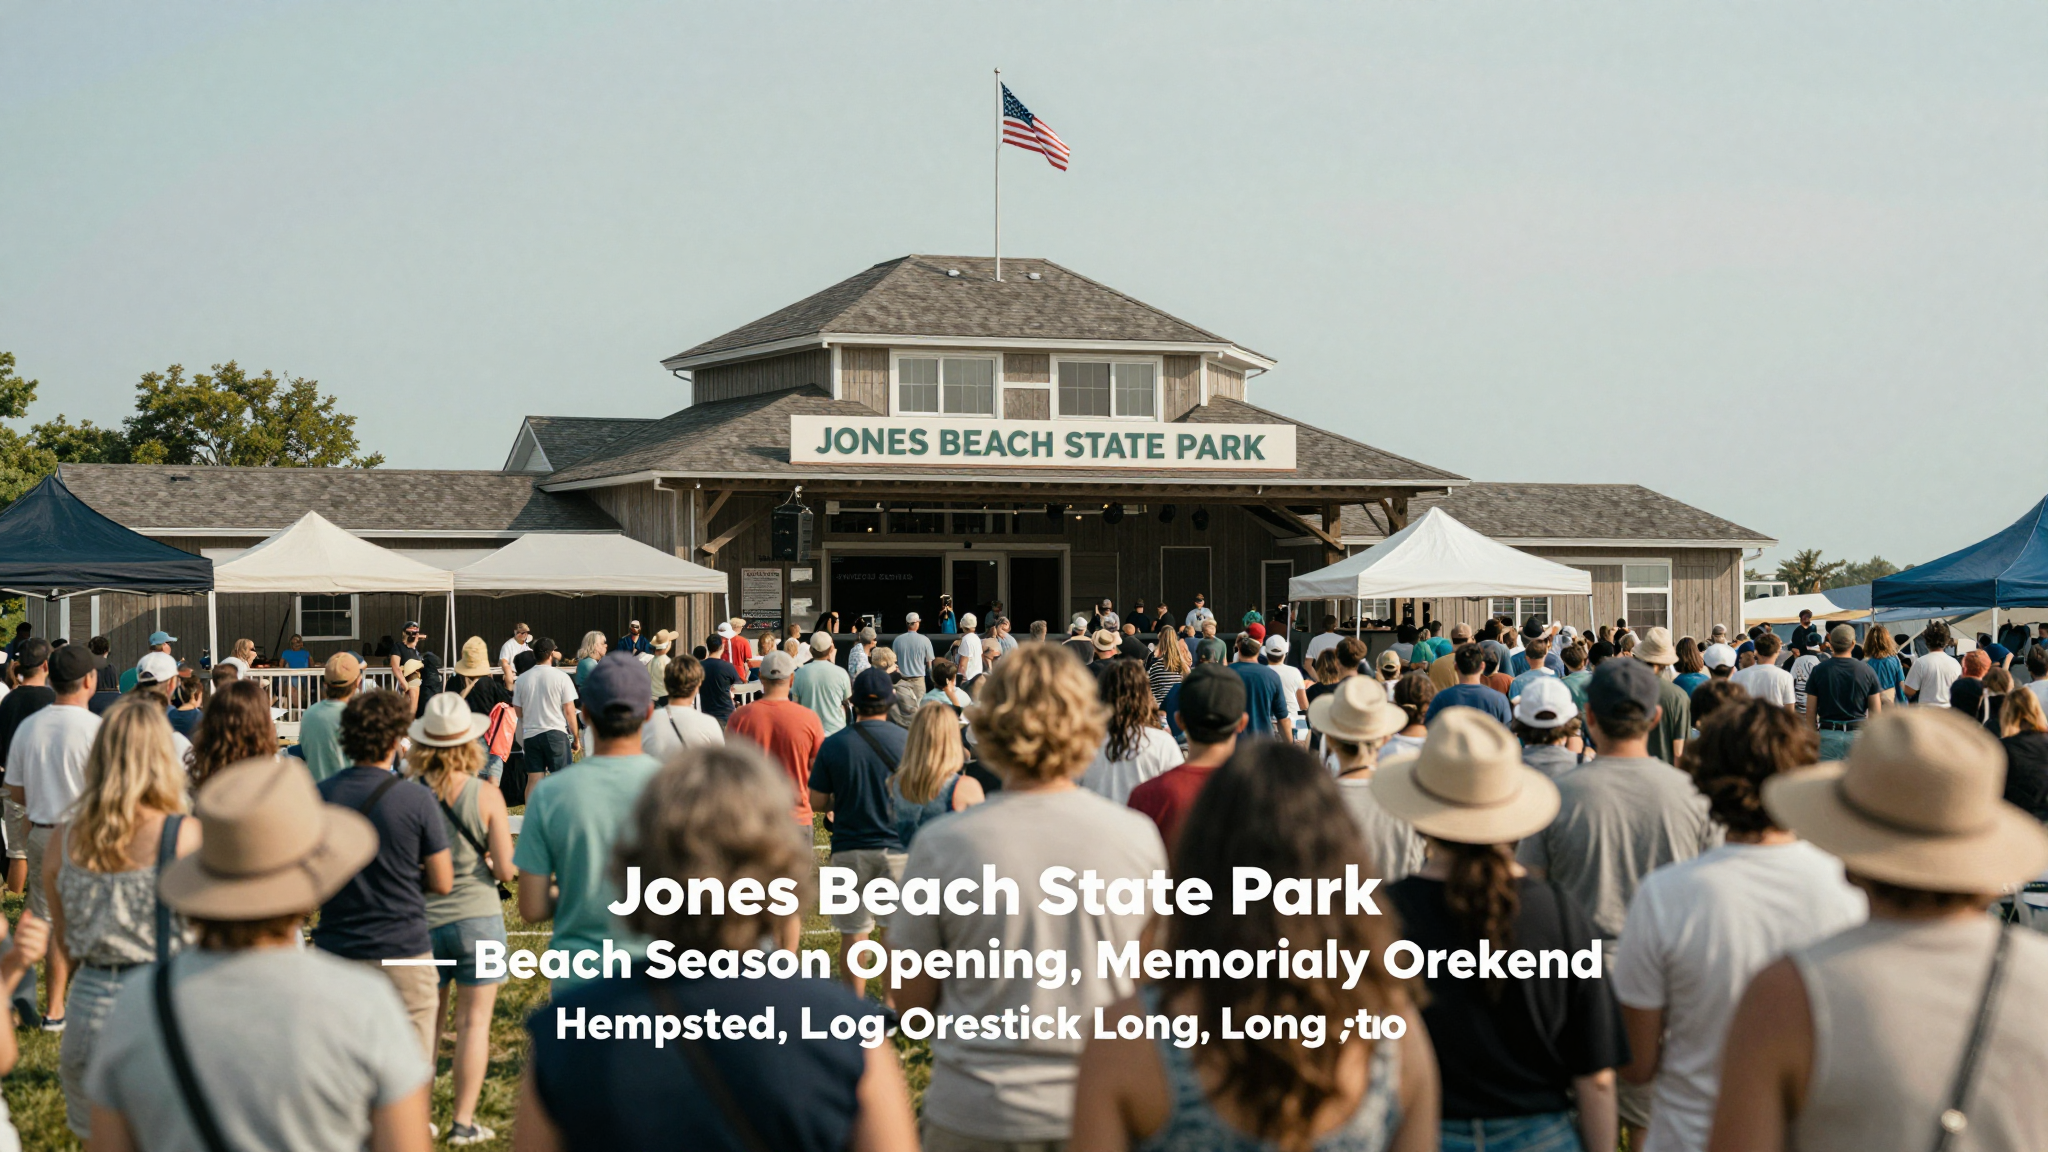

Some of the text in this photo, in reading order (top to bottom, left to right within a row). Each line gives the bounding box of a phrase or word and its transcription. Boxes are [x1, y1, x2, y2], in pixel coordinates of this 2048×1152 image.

[816, 427, 1266, 461] JONES BEACH STATE PARK
